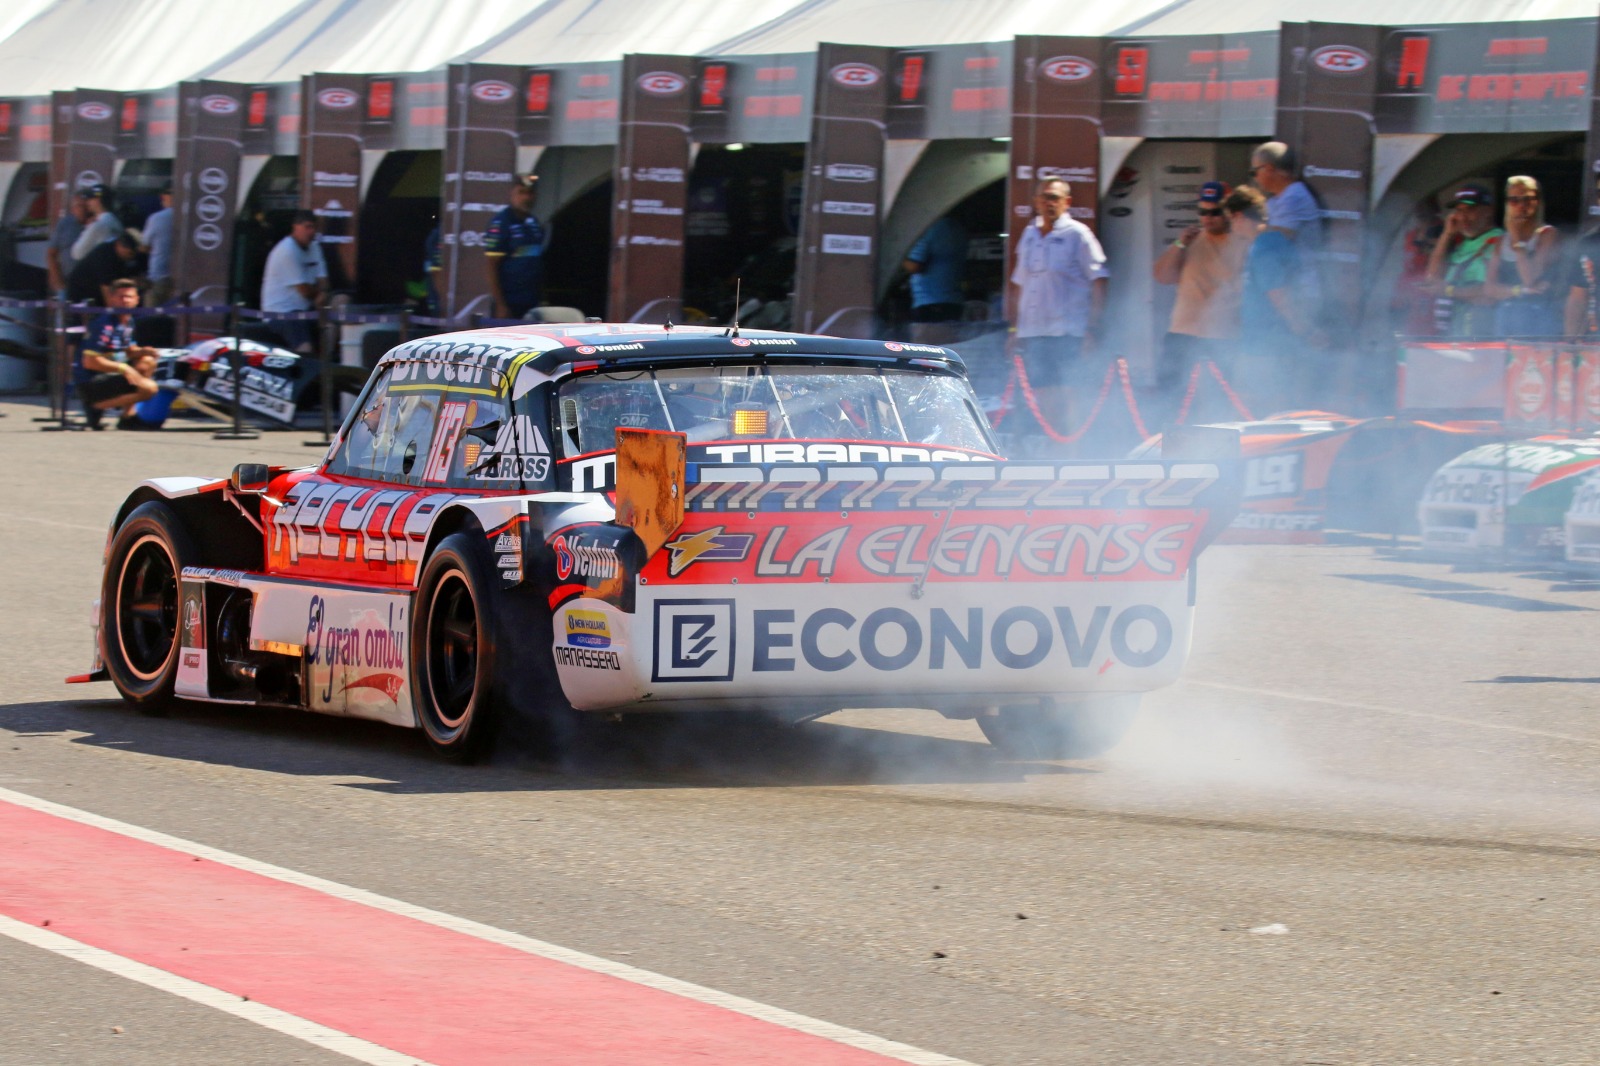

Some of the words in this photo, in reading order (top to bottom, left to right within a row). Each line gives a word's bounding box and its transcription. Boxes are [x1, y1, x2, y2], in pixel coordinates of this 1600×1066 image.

[595, 342, 643, 352] Venturi
[750, 338, 797, 346] Venturi
[902, 344, 945, 355] Venturi
[620, 416, 649, 426] OMP
[685, 463, 1220, 509] MANASSERO
[567, 535, 620, 579] Venturi
[757, 526, 851, 575] LA
[858, 523, 1194, 575] ELENENSE
[575, 619, 586, 629] NEW
[586, 620, 606, 631] HOLLAND
[306, 595, 324, 665] El
[323, 626, 361, 703] gran
[364, 602, 404, 669] ombú
[752, 605, 1173, 672] ECONOVO
[555, 646, 621, 671] MANASSERO
